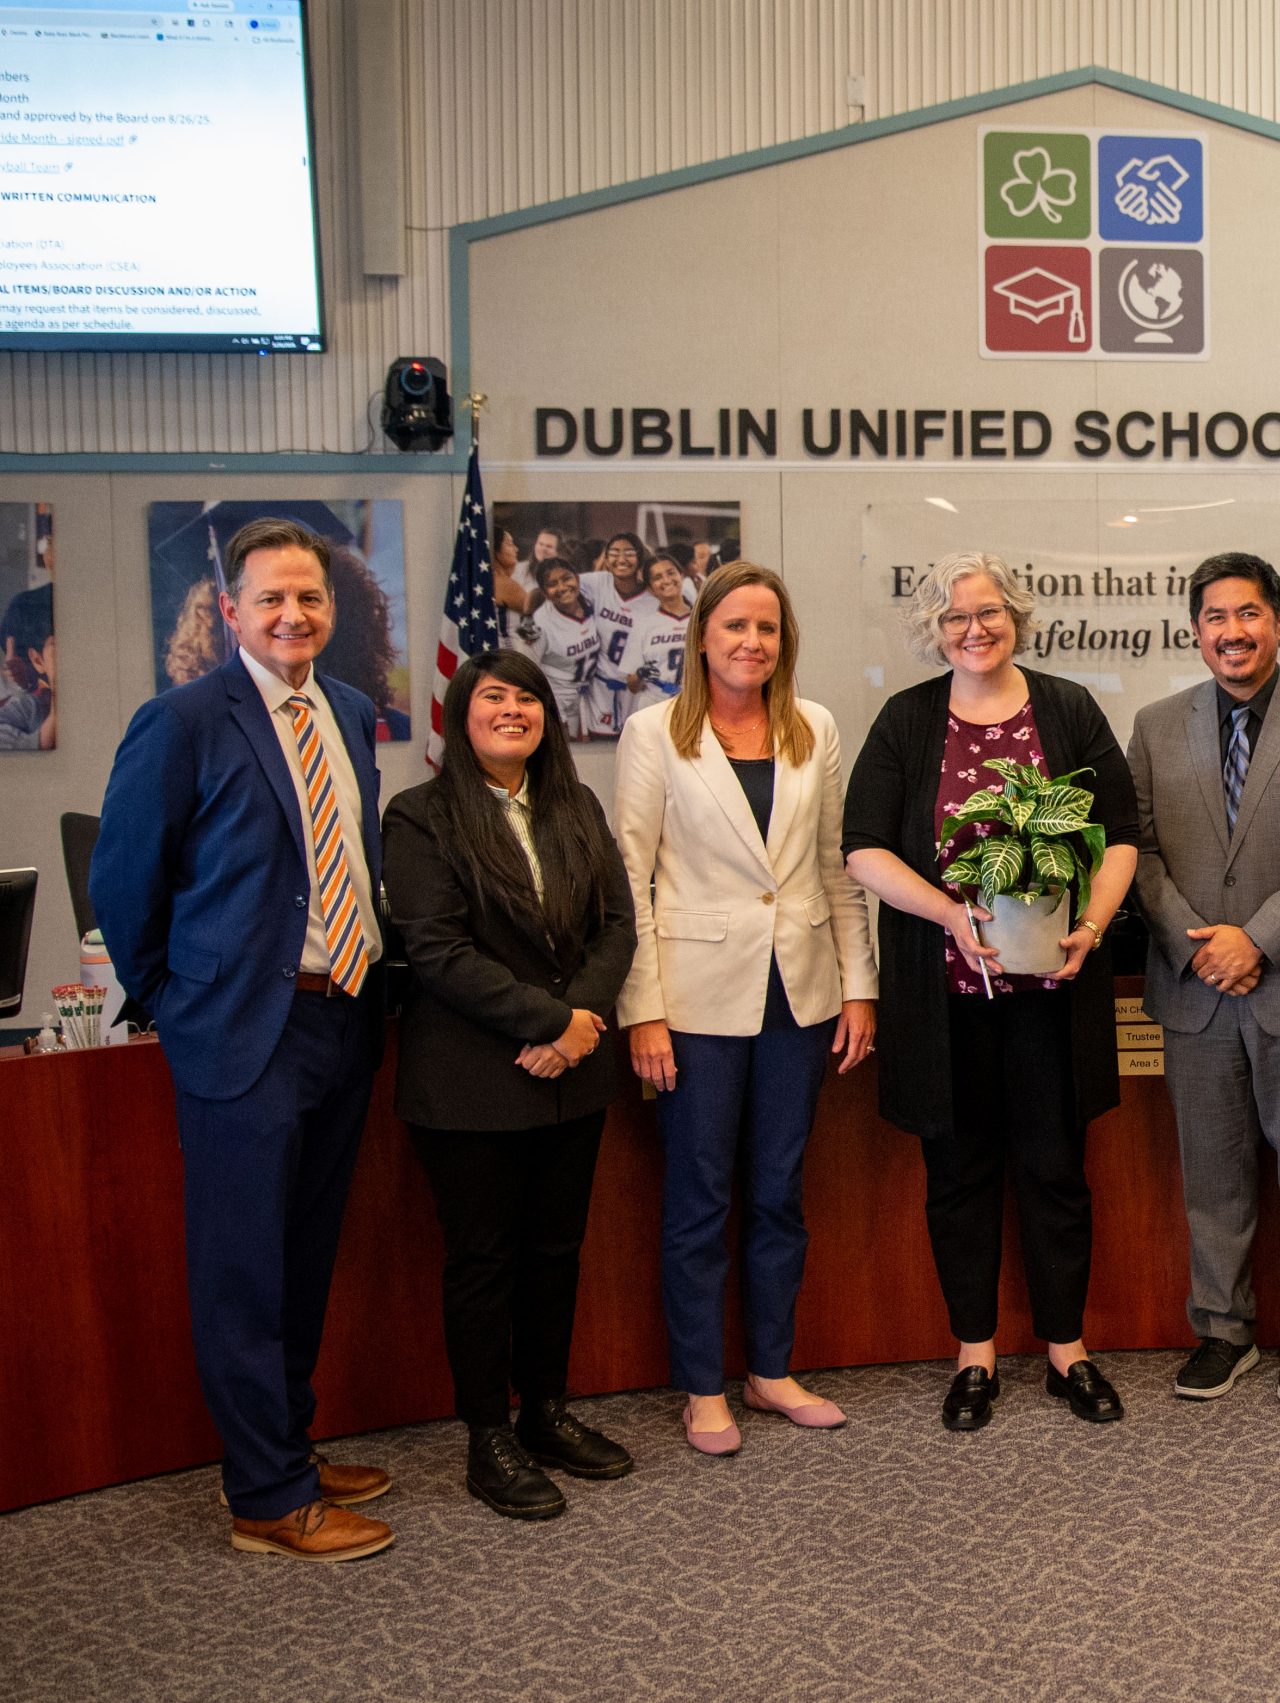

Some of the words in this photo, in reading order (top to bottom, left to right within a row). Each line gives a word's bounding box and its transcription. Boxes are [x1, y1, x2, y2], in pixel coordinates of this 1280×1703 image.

[0, 111, 20, 121] and
[24, 112, 76, 123] approved
[80, 112, 92, 124] by
[96, 112, 113, 122] the
[117, 113, 148, 123] Board
[152, 116, 166, 124] on
[1, 192, 54, 201] WRITTEN
[57, 193, 157, 203] COMMUNICATION
[13, 285, 92, 295] ITEMS/BOARD
[95, 286, 165, 296] DISCUSSION
[167, 287, 212, 296] AND/OR
[214, 287, 257, 296] ACTION
[25, 305, 65, 315] request
[68, 304, 90, 314] that
[93, 305, 122, 314] items
[126, 305, 139, 314] be
[5, 320, 45, 331] agenda
[62, 321, 80, 330] per
[535, 408, 777, 456] DUBLIN
[803, 408, 1052, 457] UNIFIED
[1091, 567, 1156, 597] that
[1027, 619, 1152, 658] ifelong
[608, 630, 629, 666] 6
[1126, 1033, 1161, 1041] Trustee
[1129, 1059, 1151, 1068] Area
[1153, 1059, 1159, 1067] 5
